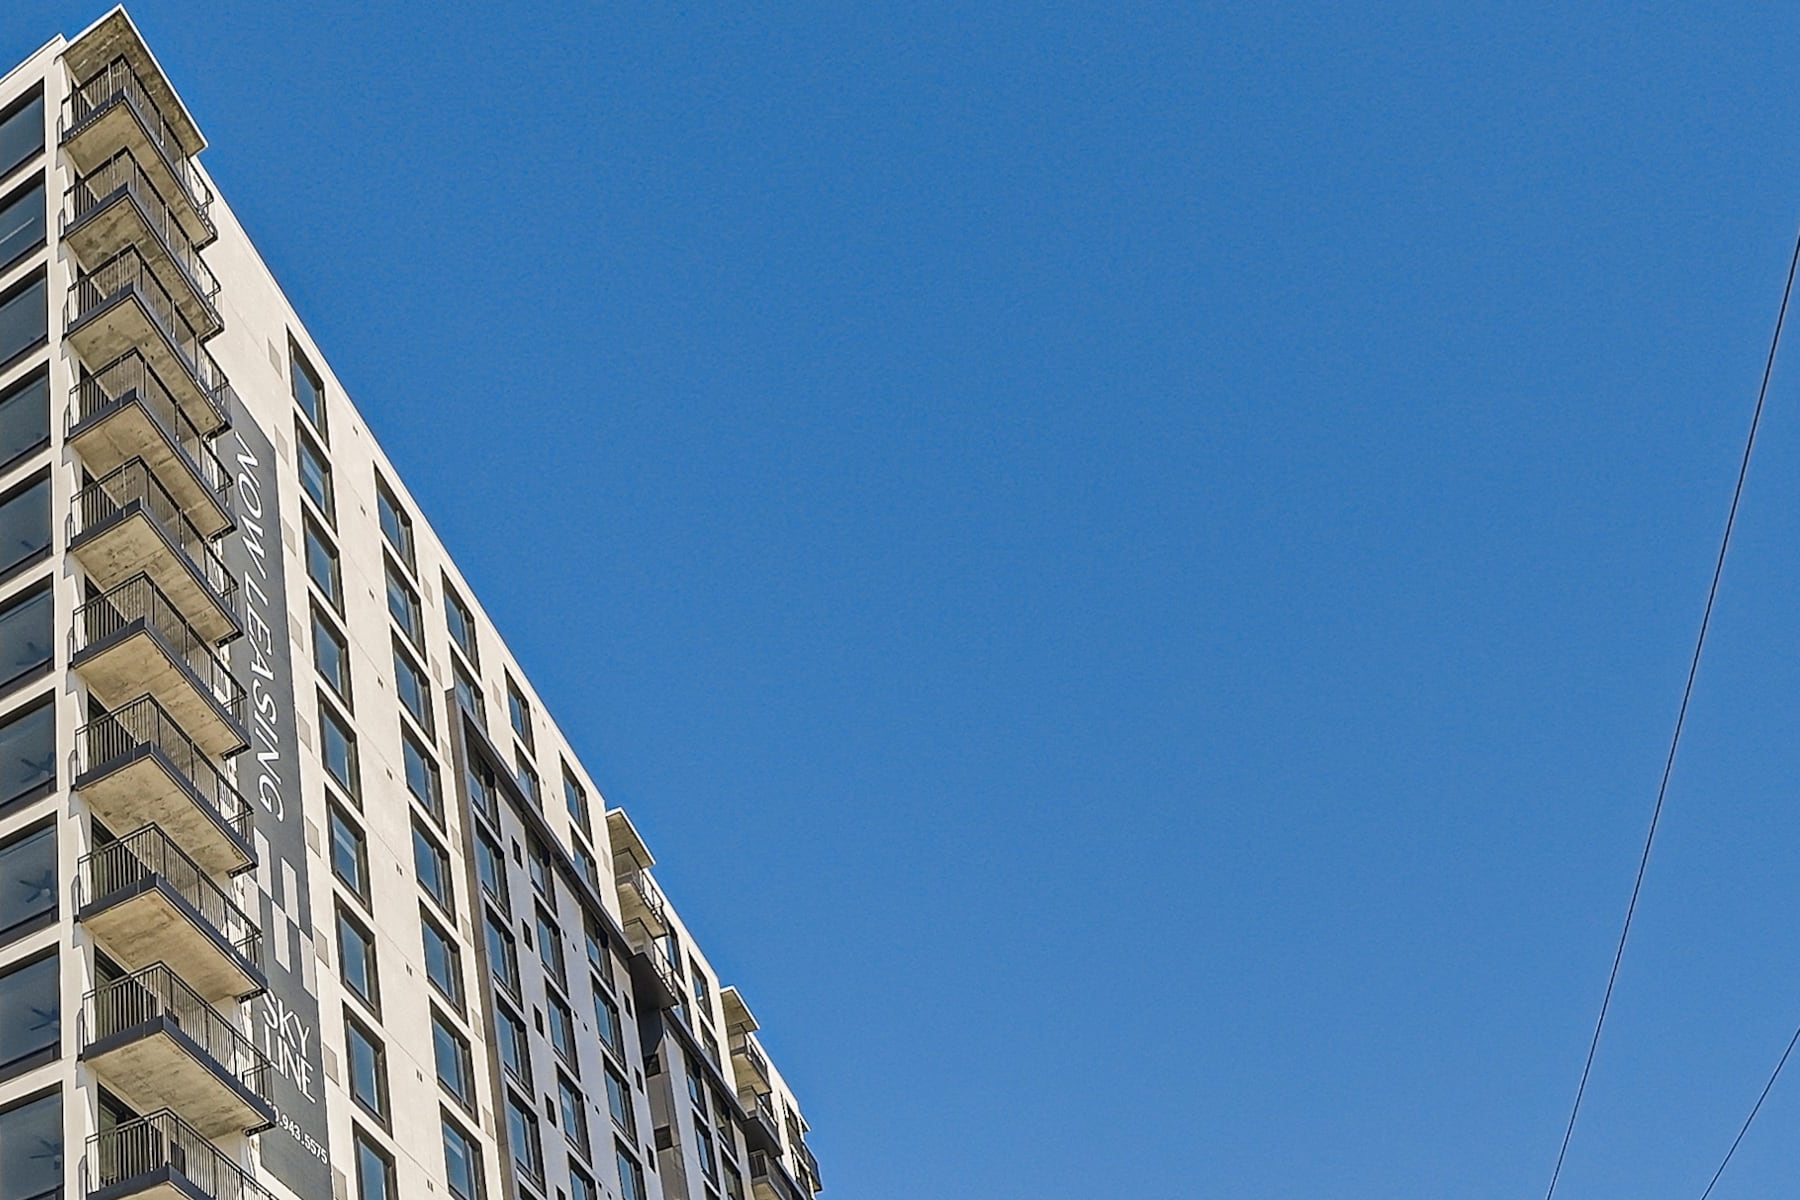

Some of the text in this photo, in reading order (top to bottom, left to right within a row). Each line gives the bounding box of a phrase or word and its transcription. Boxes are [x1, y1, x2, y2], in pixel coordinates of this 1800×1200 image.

[234, 431, 286, 822] NOW LEASING
[262, 988, 310, 1058] SKY
[264, 1022, 316, 1104] LINE
[261, 1094, 328, 1164] 0.943.5575
